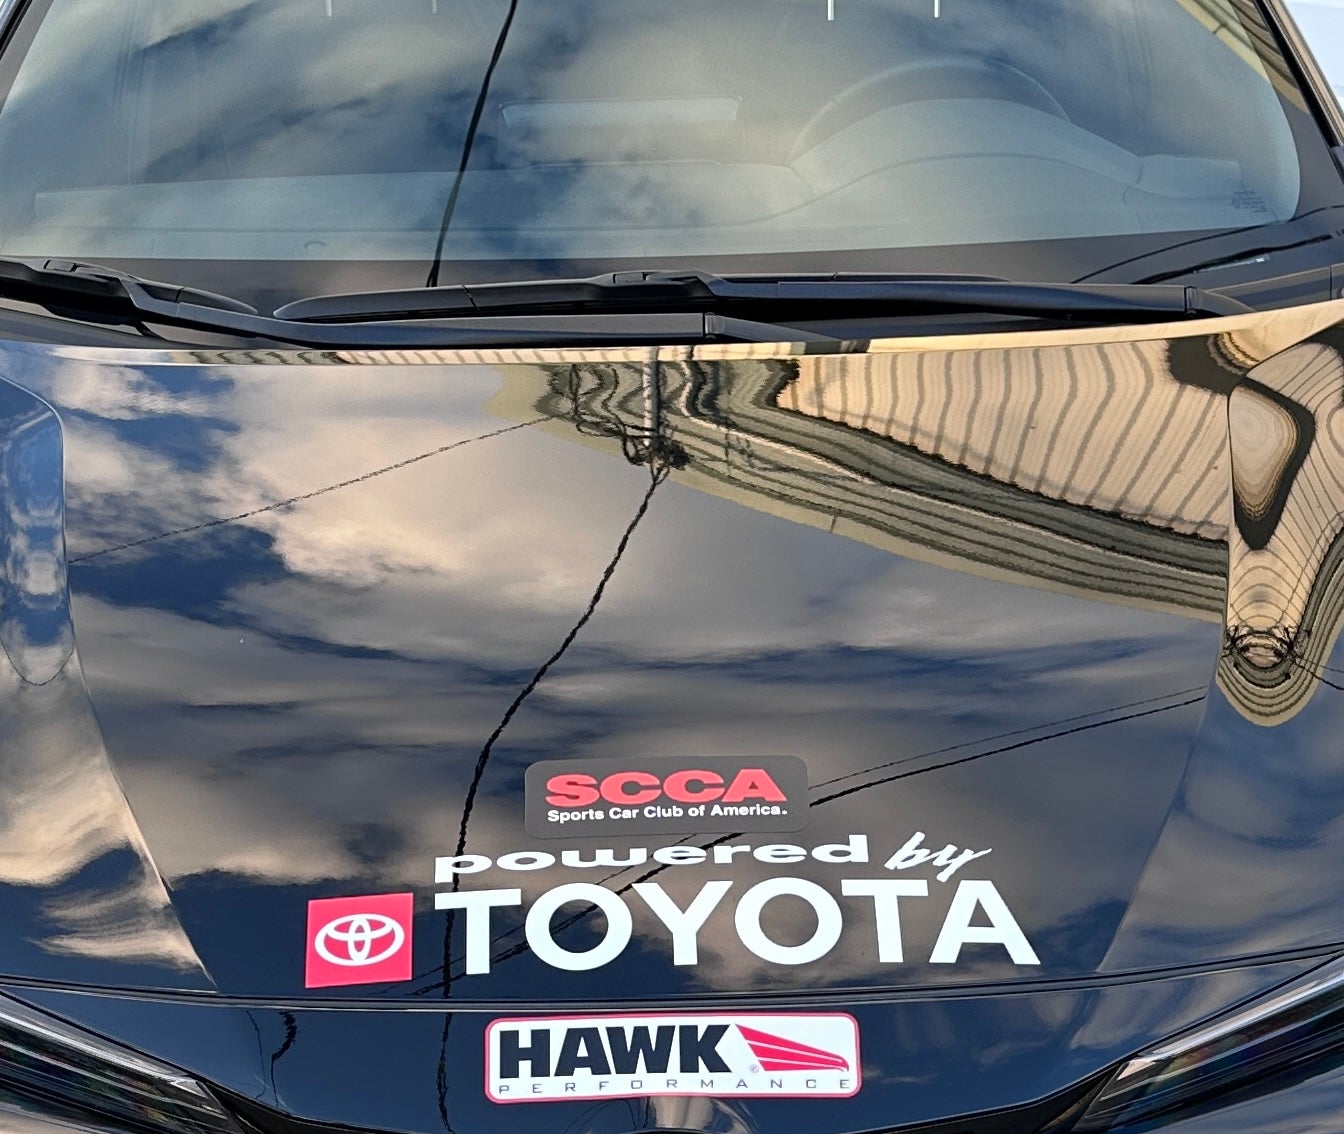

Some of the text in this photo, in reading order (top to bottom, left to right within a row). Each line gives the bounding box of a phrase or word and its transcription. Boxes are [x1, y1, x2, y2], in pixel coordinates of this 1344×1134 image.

[545, 768, 788, 808] SCCA
[547, 804, 789, 824] Sports Car Club of America.
[434, 831, 992, 884] powered by
[434, 876, 1042, 976] TOYOTA
[499, 1023, 733, 1079] HAWK
[499, 1078, 851, 1095] PERFORMANCE
